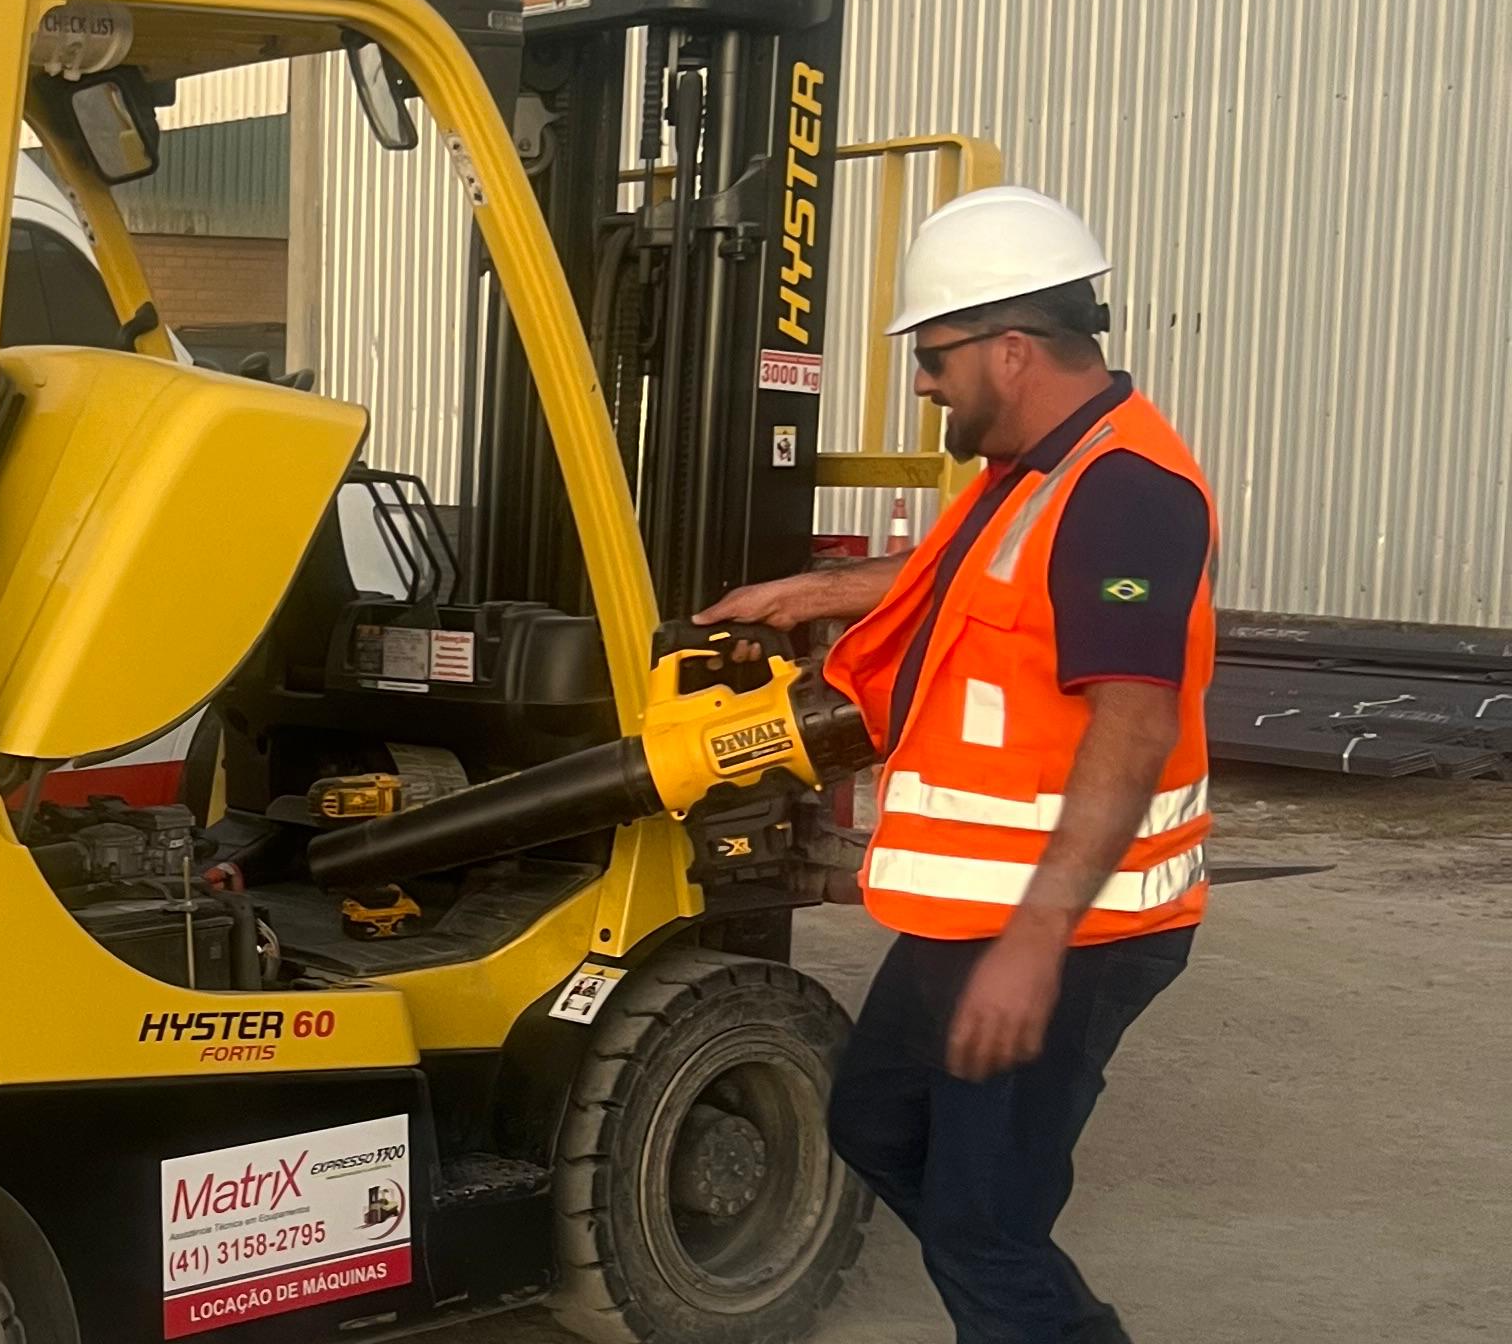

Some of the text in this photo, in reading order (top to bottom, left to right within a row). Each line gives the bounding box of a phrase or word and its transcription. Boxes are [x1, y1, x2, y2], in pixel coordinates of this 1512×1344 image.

[90, 17, 114, 36] LIST
[778, 61, 825, 345] HYSTER
[761, 362, 820, 391] 3000 kg
[138, 1010, 336, 1043] HYSTER 60
[199, 1044, 277, 1063] FORTIS
[310, 1152, 375, 1176] EXPRESSO
[168, 1221, 326, 1281] (41) 3158-2795
[189, 1262, 388, 1322] LOCAÇÃO DE MÁQUINAS
